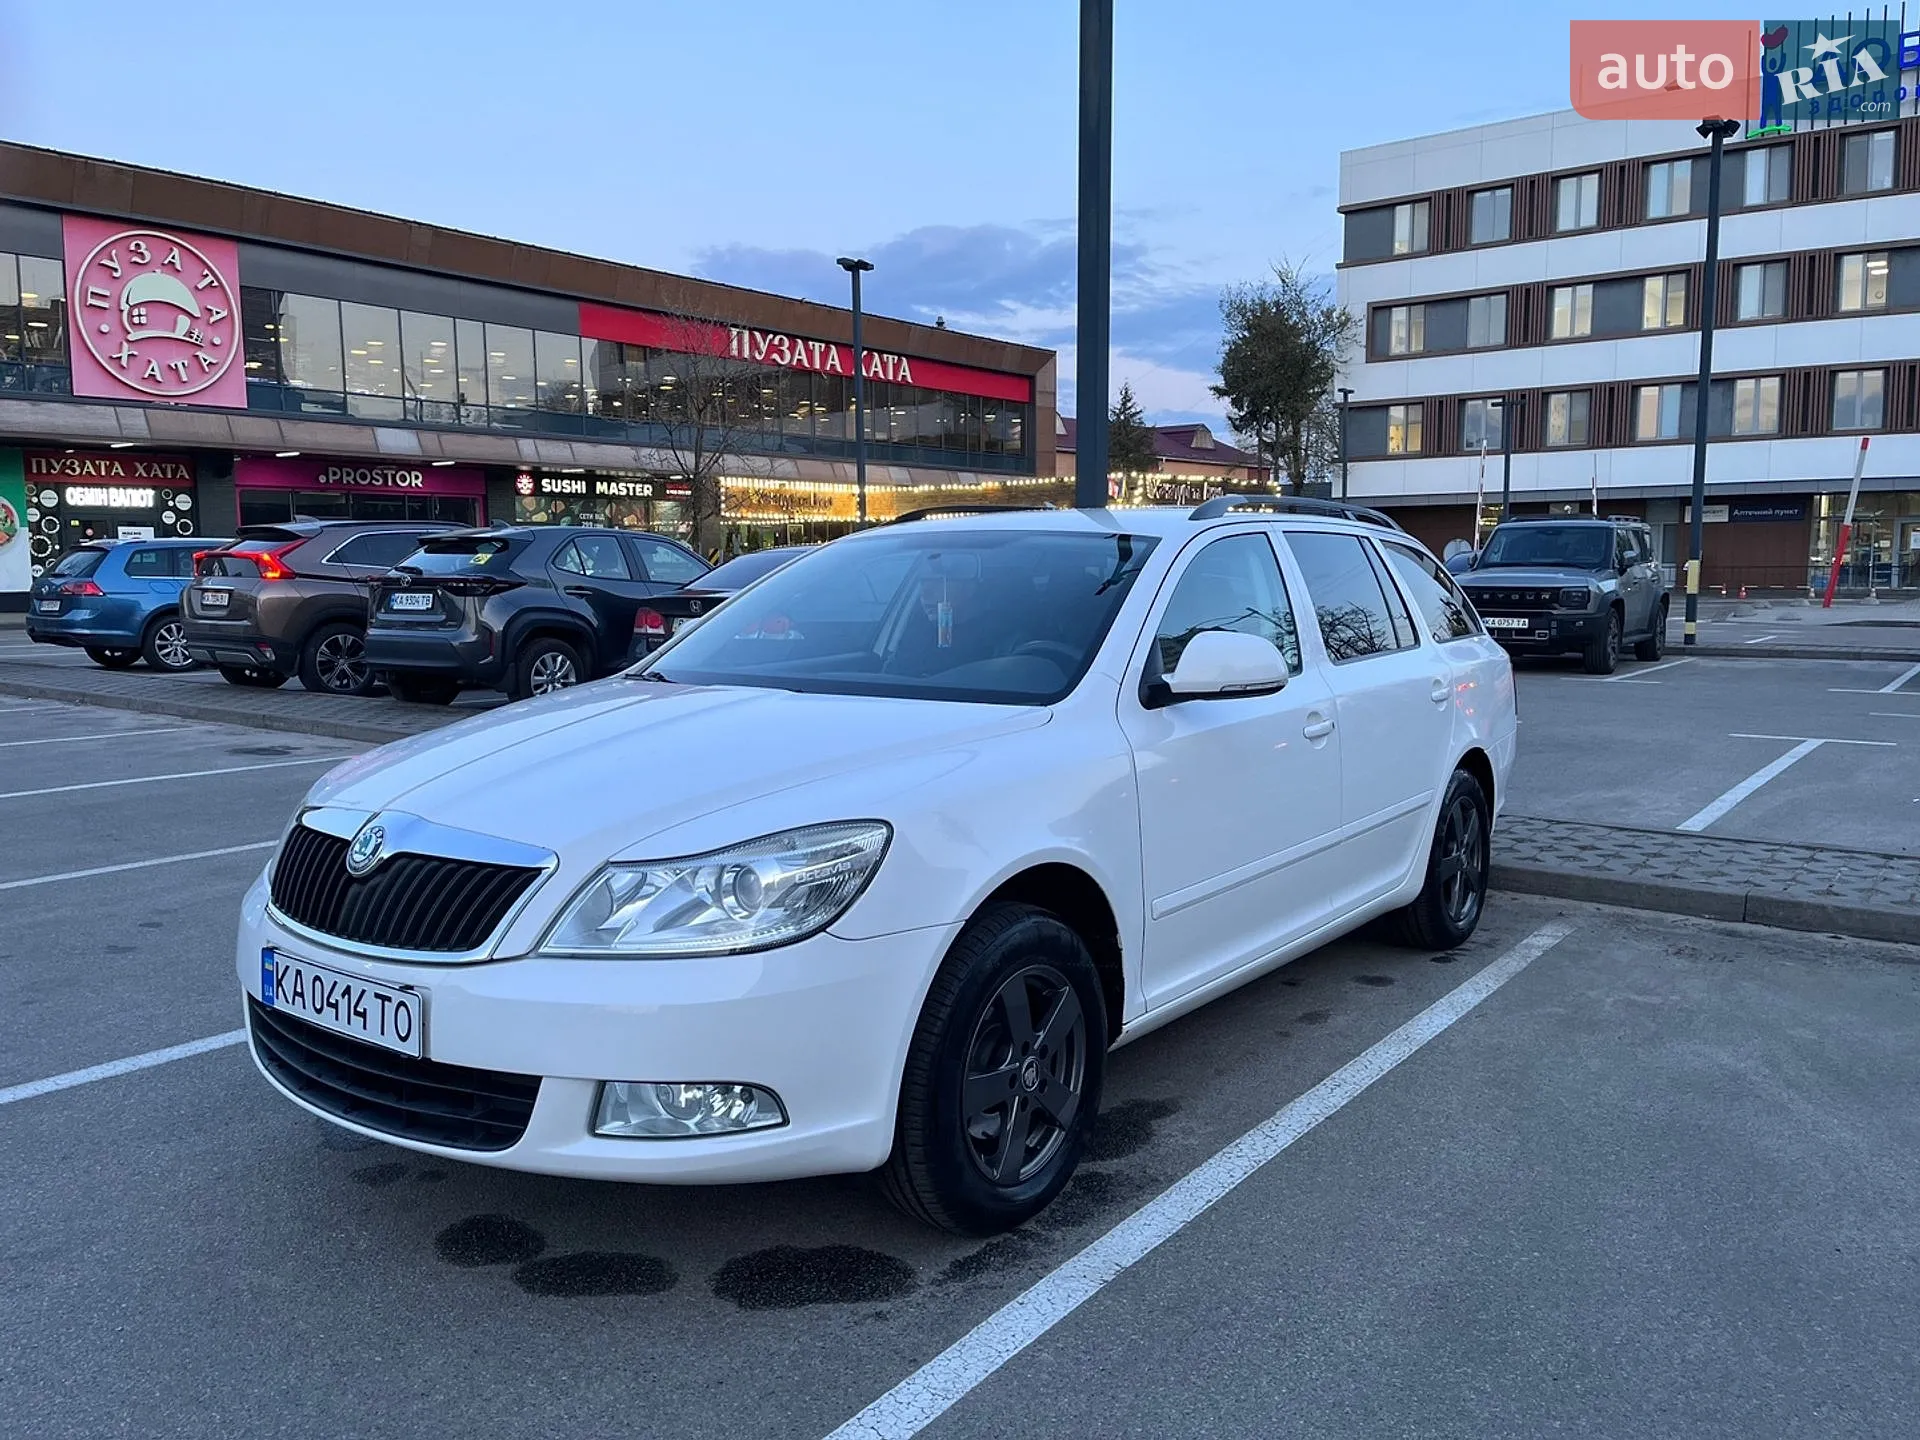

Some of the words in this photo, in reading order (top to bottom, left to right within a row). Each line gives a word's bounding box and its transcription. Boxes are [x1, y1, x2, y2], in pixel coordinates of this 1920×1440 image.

[86, 240, 228, 324] ПУЗАТА
[112, 341, 218, 383] ХАТА
[728, 327, 843, 373] ПУЗАТА
[31, 457, 126, 477] ПУЗАТА
[134, 462, 190, 479] ХАТА
[328, 467, 423, 488] PROSTOR
[541, 478, 586, 494] SUSHI
[595, 481, 653, 497] MASTER
